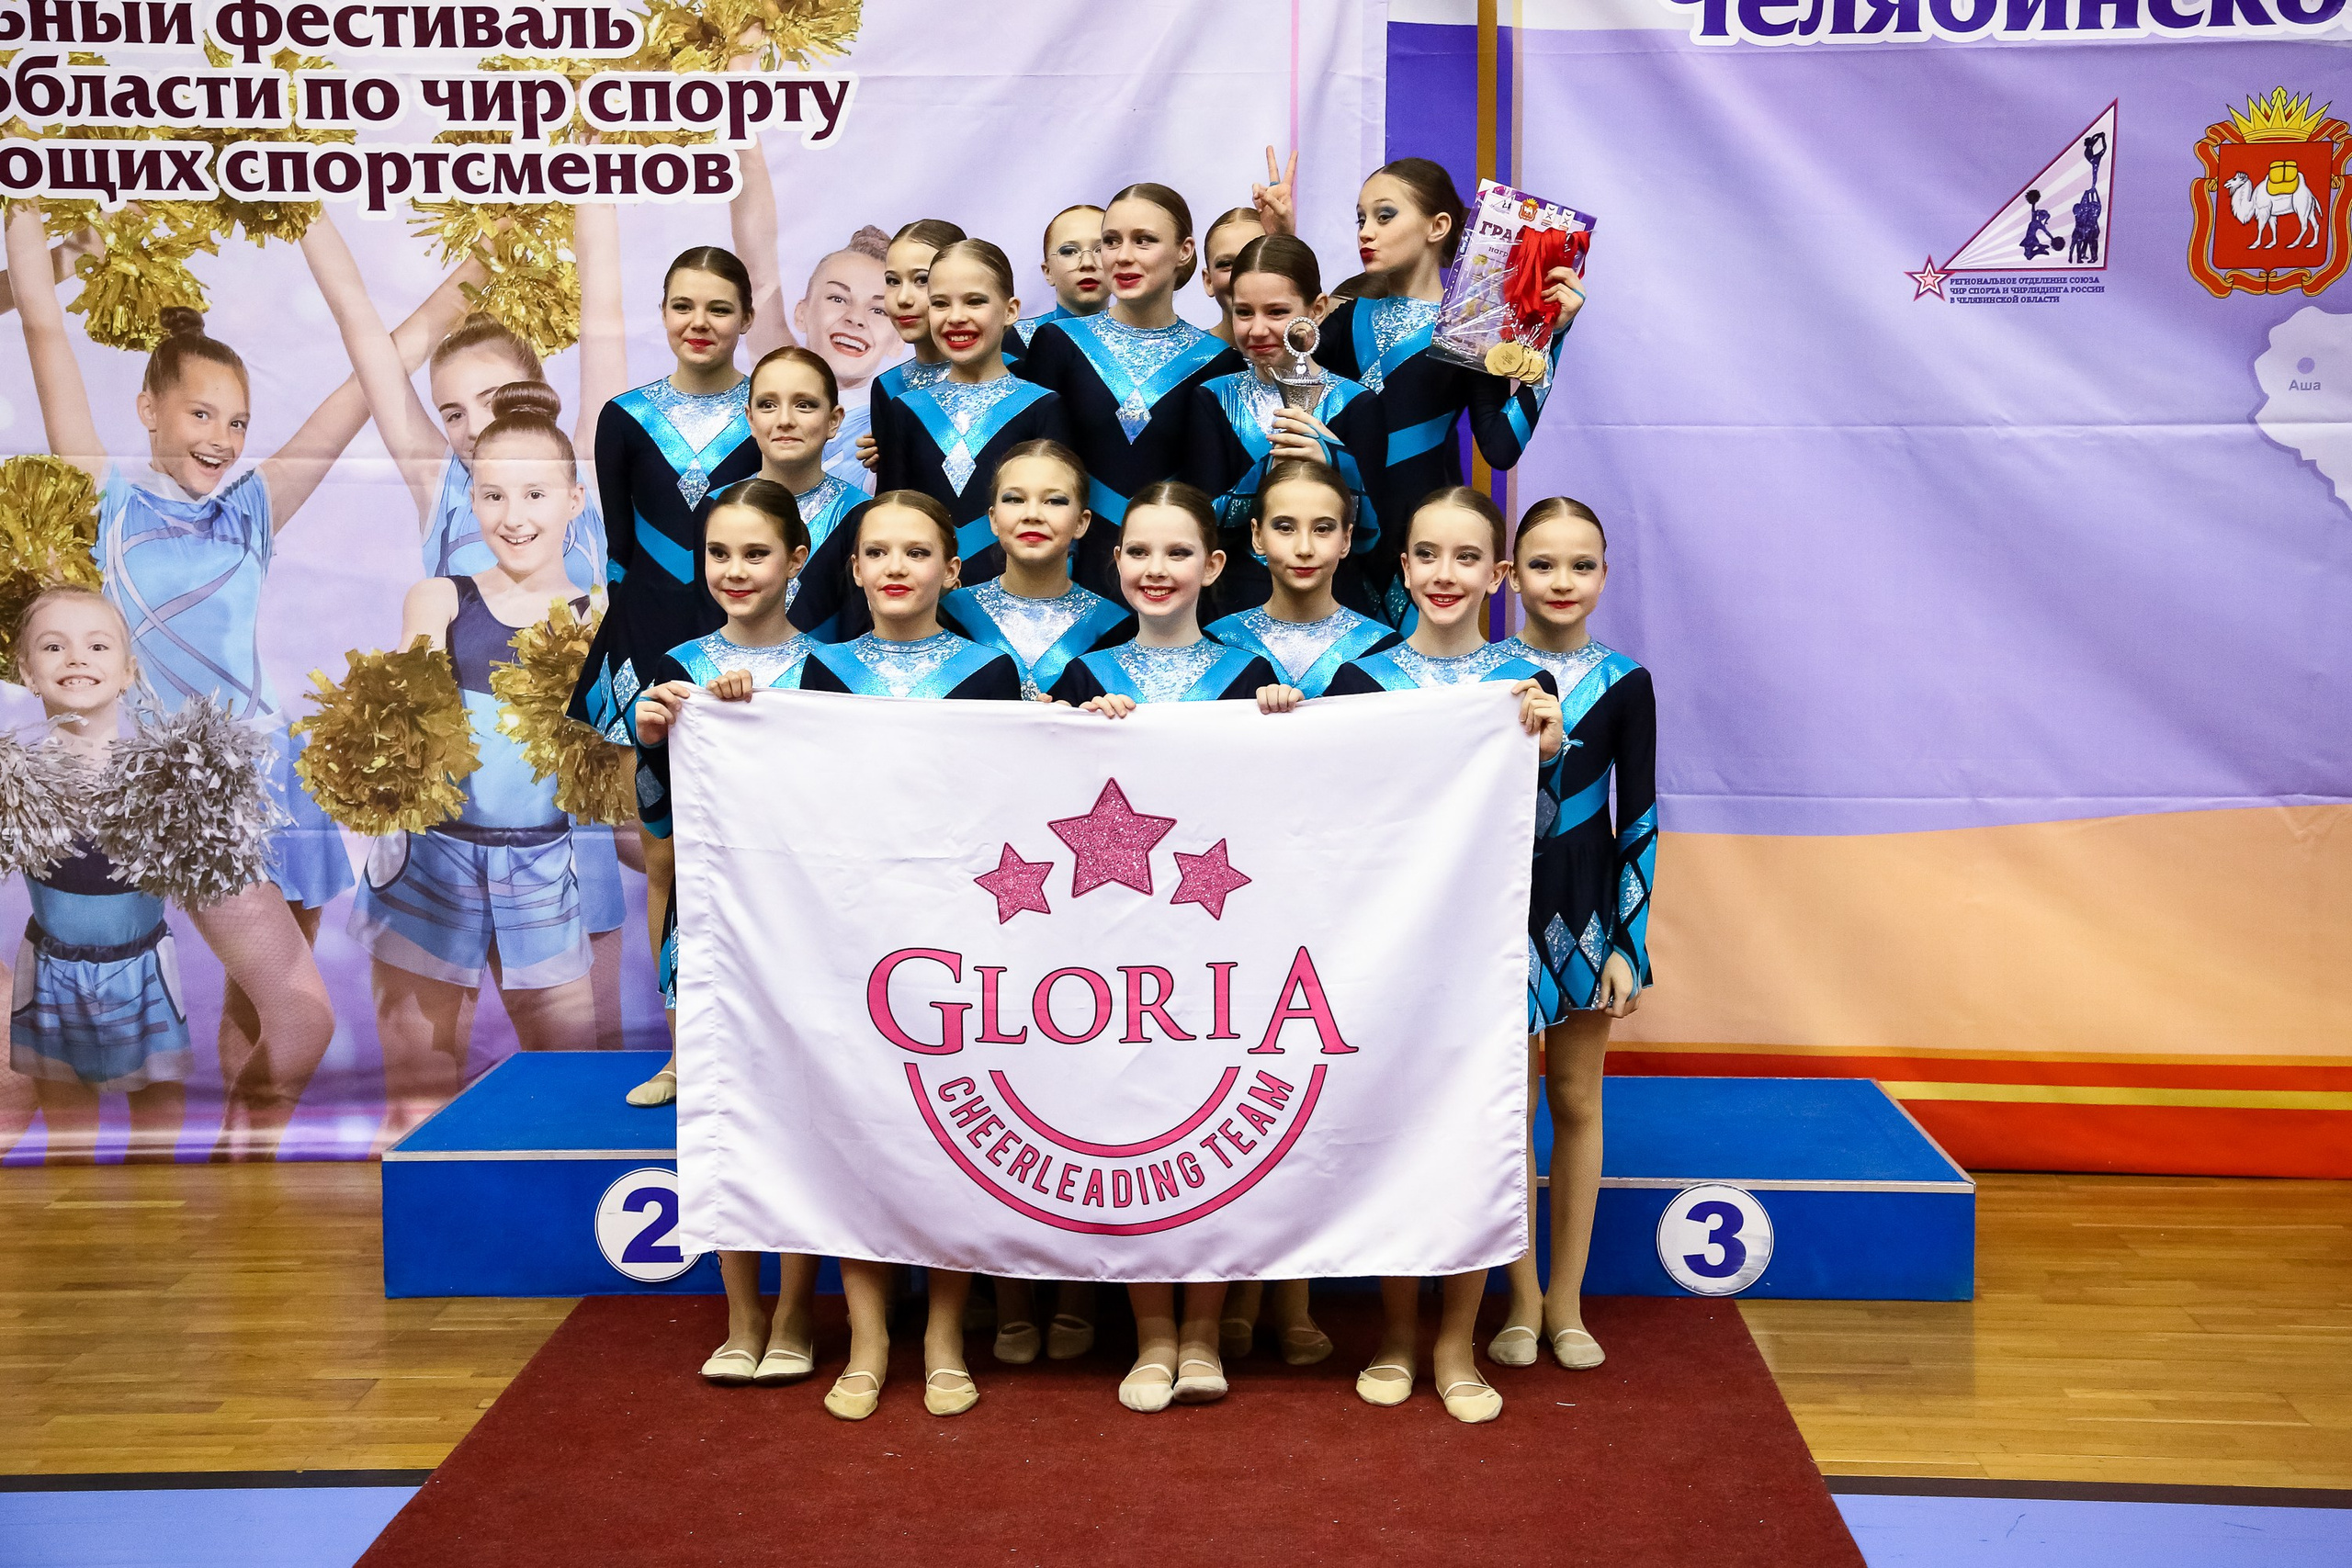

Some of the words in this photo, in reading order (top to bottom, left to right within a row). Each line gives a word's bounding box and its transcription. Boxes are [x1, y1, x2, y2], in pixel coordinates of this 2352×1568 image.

[216, 0, 635, 63] фестиваль
[0, 54, 282, 119] бласти
[304, 78, 399, 120] по
[422, 80, 565, 140] чир
[588, 80, 850, 140] спорту
[225, 150, 733, 211] спортсменов
[1950, 277, 2017, 286] РЕГИОНАЛЬНОЕ
[1957, 294, 2018, 304] ЧЕЛЯБИНСКОЙ
[2010, 286, 2069, 294] ЧИРЛИДИНГА
[2288, 379, 2321, 391] Аша
[866, 945, 1359, 1055] GLORIA
[936, 1076, 1205, 1208] CHEERLEADING
[1200, 1069, 1295, 1169] TEAM
[621, 1186, 684, 1263] 2
[1682, 1201, 1747, 1279] 3
